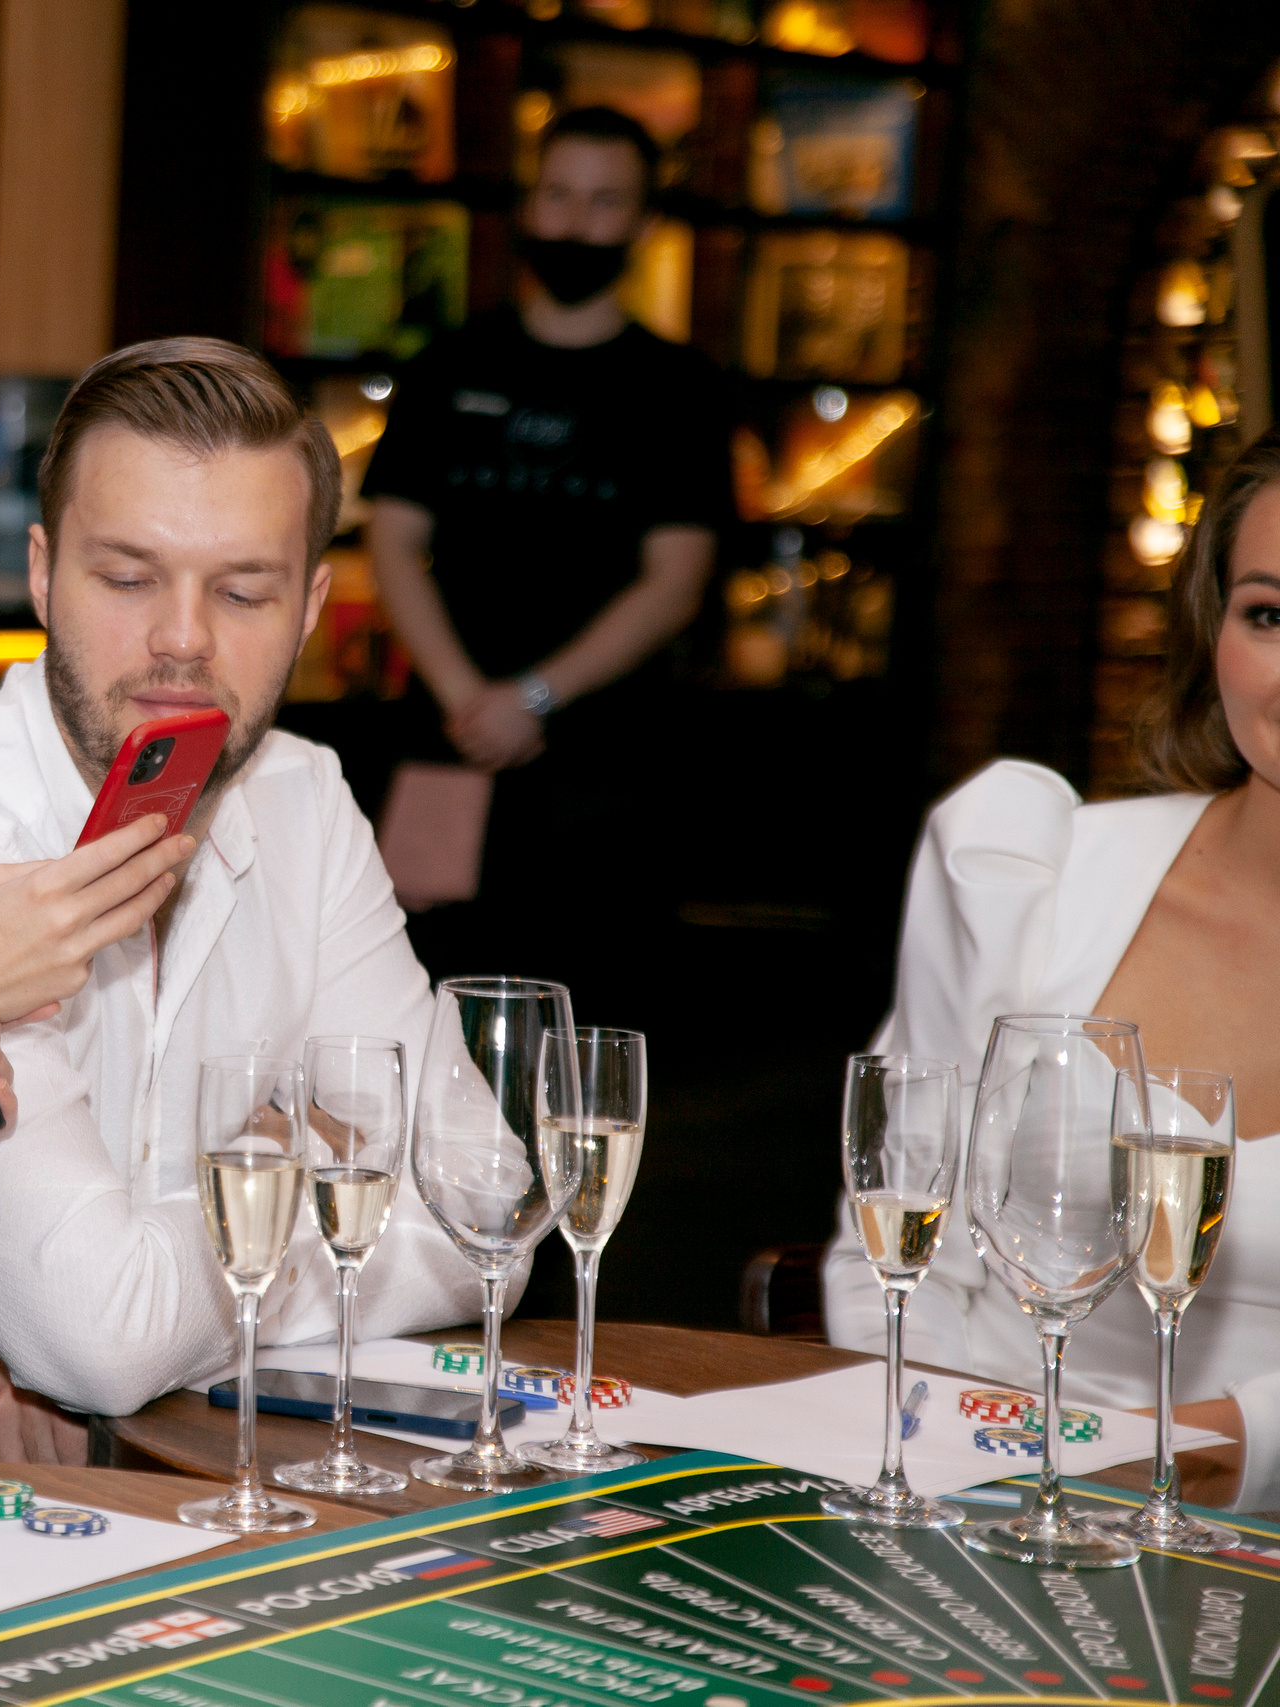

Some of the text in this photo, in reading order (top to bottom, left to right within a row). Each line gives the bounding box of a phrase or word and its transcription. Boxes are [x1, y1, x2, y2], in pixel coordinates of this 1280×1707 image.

[489, 1525, 593, 1554] США
[237, 1567, 415, 1617] РОССИЯ
[639, 1571, 872, 1666] МОНАСТРЕЛЬ
[796, 1584, 952, 1662] САПЕРАВИ
[448, 1620, 708, 1692] ВЕЛЬТЛИНЕР
[534, 1599, 778, 1675] ЦВАЙГЕЛЬТ
[1071, 1630, 1133, 1670] НЕРО
[1189, 1587, 1247, 1679] КСИНОМАВРО
[502, 1653, 673, 1703] ГРЮНЕР
